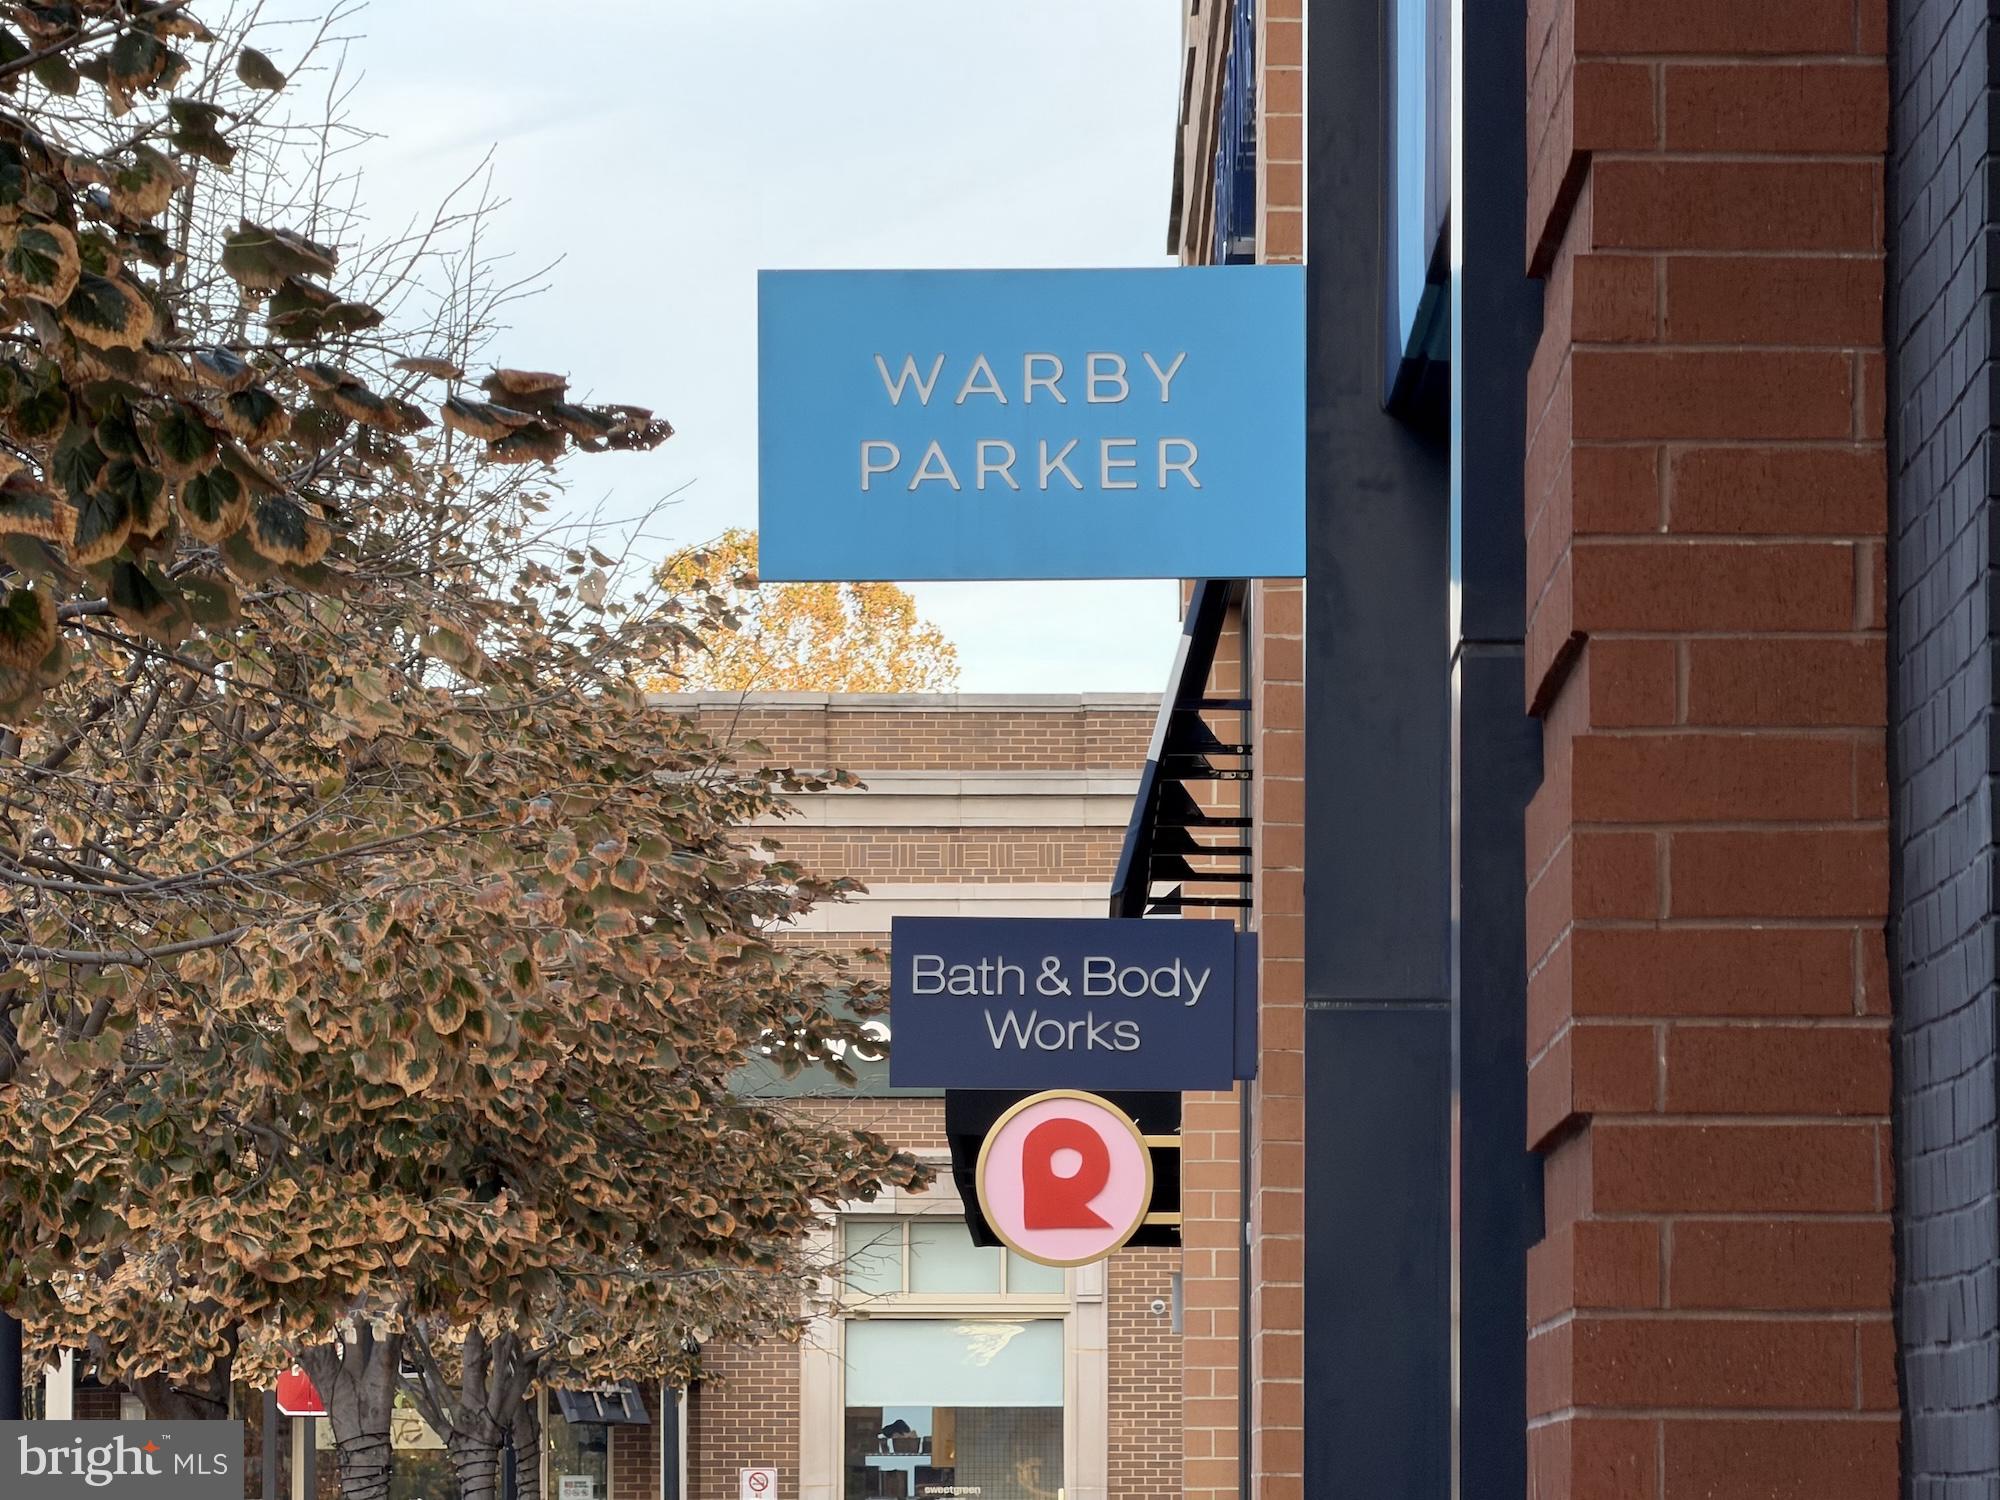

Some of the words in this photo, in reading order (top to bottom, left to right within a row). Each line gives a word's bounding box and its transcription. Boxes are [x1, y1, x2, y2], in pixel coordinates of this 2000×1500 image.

[874, 352, 1187, 406] WARBY
[859, 437, 1202, 491] PARKER
[912, 954, 1025, 996] Bath
[1035, 955, 1072, 997] &
[1083, 956, 1211, 1007] Body
[984, 1009, 1141, 1051] Works
[1022, 1118, 1114, 1230] R
[924, 1486, 981, 1496] sweetgreen
